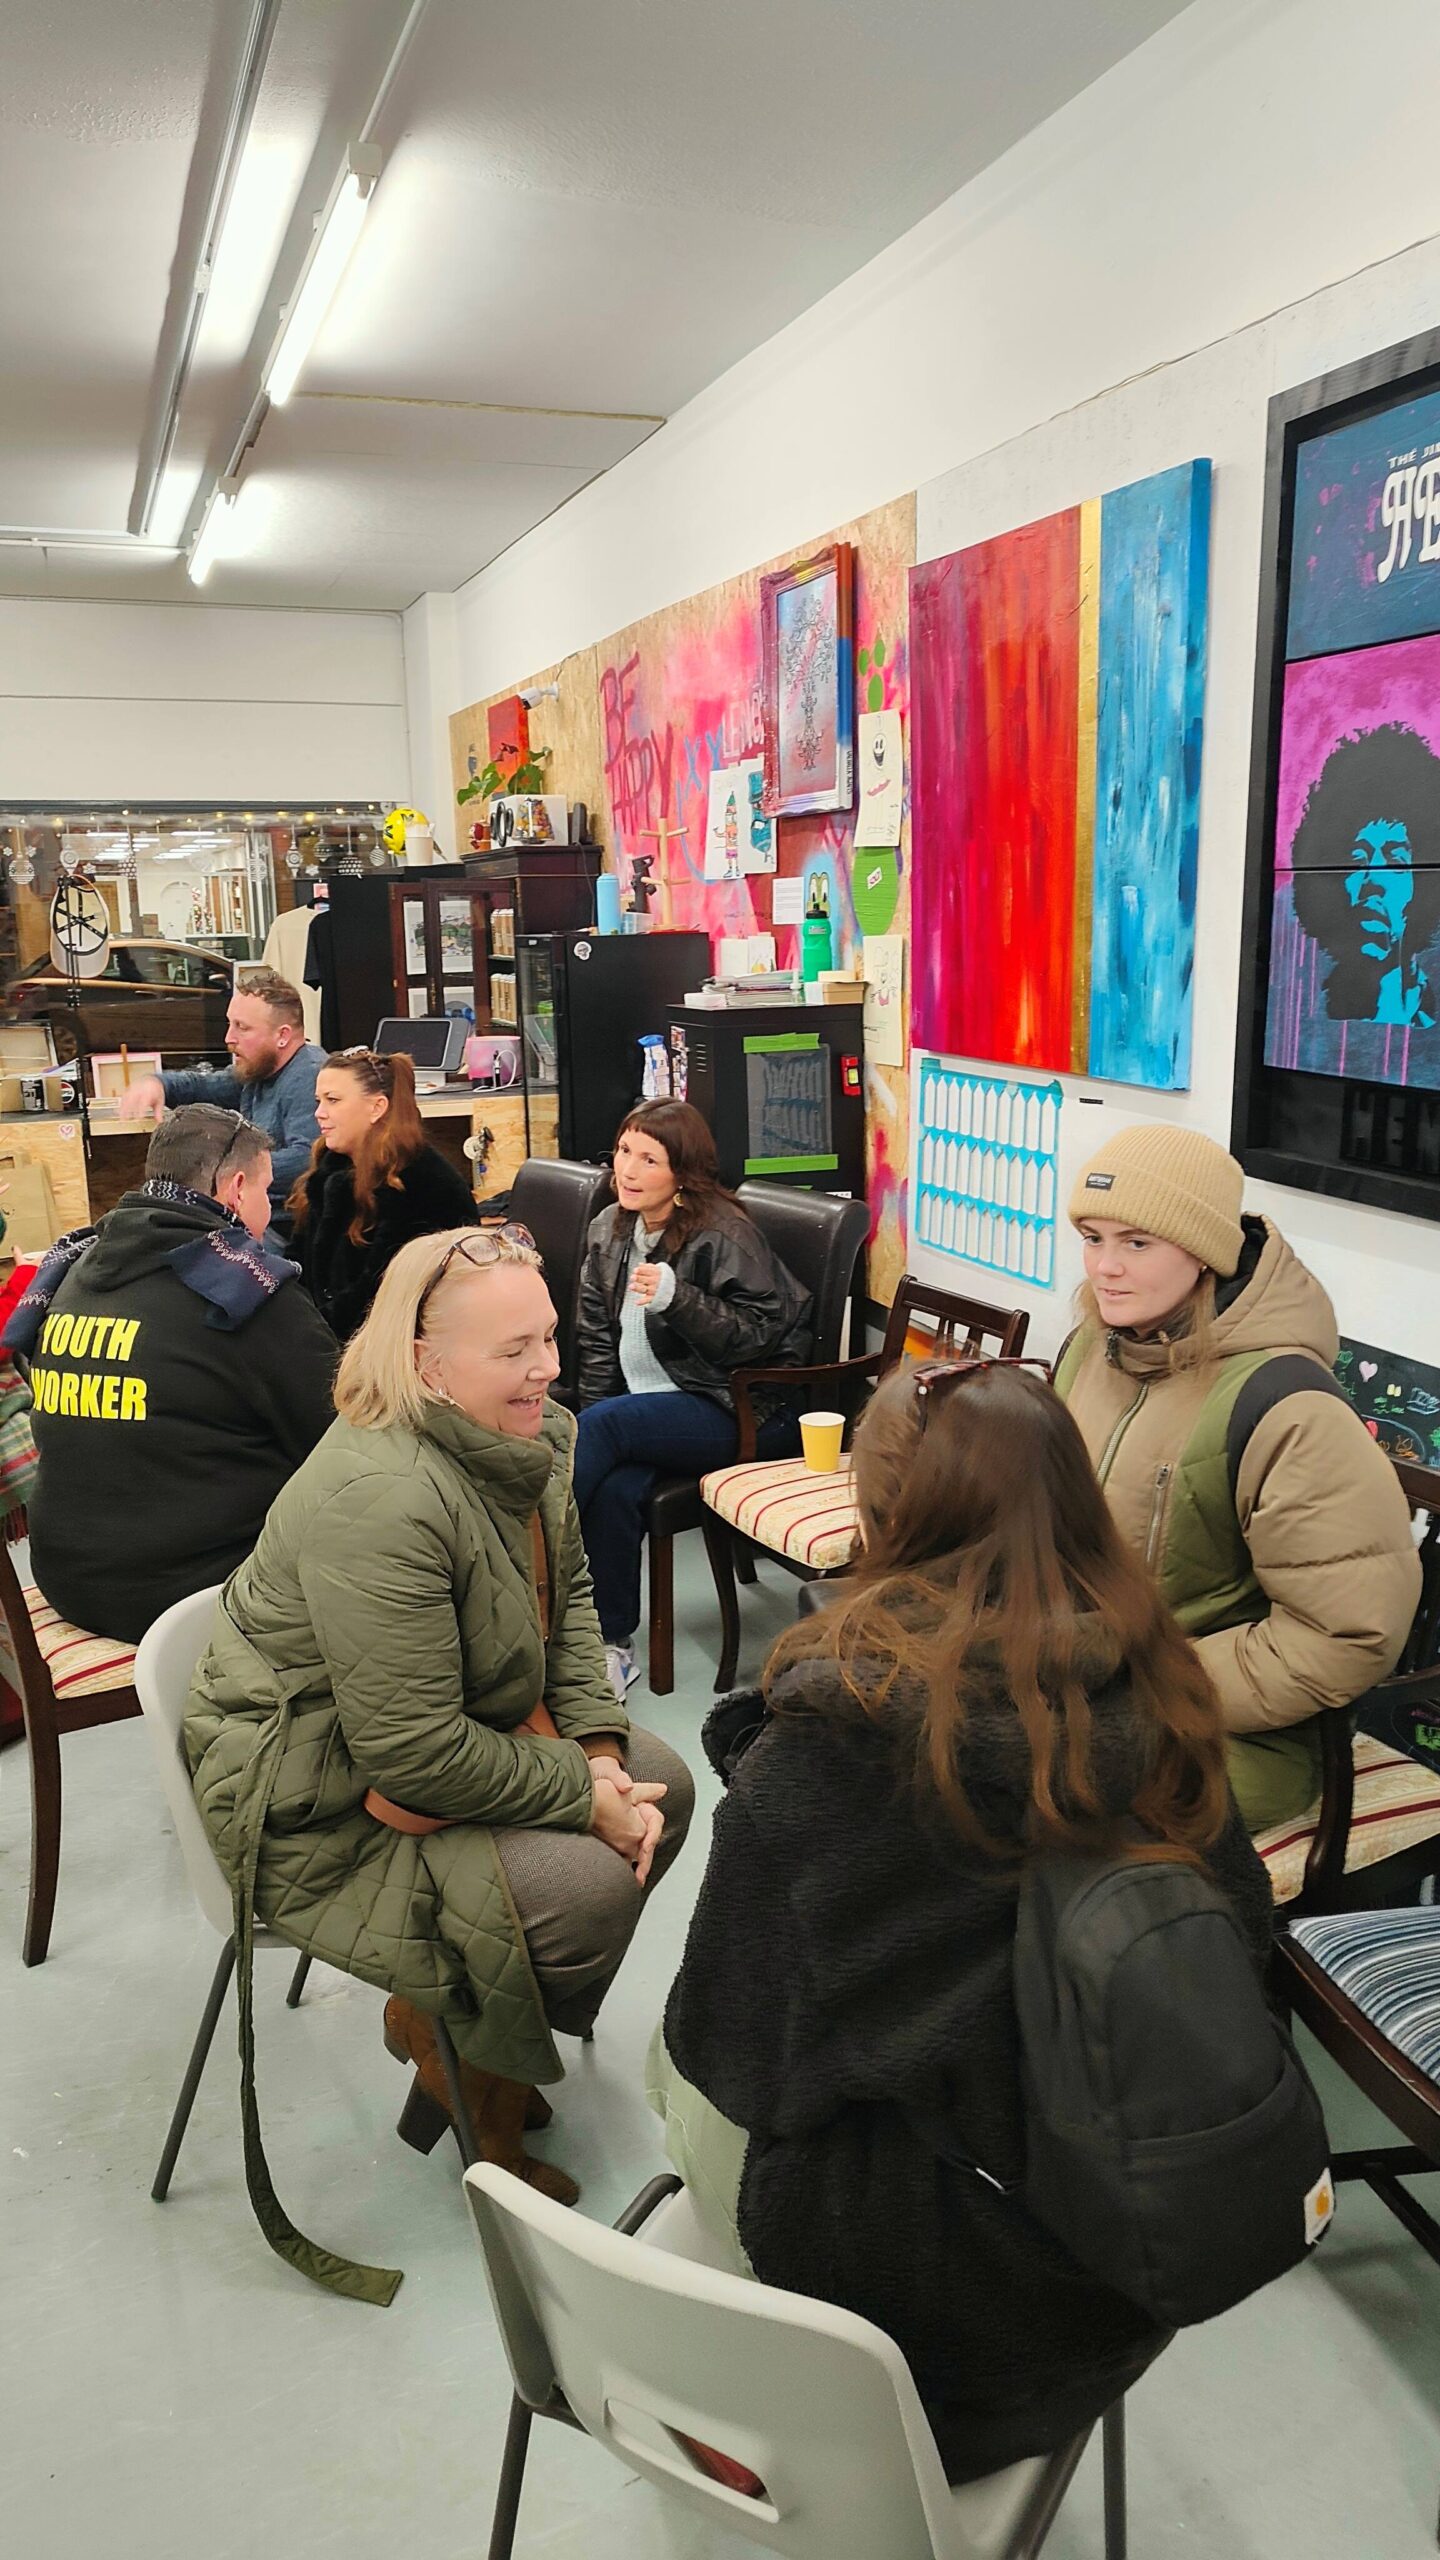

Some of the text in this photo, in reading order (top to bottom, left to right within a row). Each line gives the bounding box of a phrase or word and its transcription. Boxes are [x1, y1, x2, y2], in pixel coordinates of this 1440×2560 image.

[1387, 448, 1417, 469] THE
[600, 651, 640, 774] BE
[611, 721, 674, 835] HAPPY
[41, 1313, 142, 1362] YOUTH
[30, 1368, 148, 1421] WORKER
